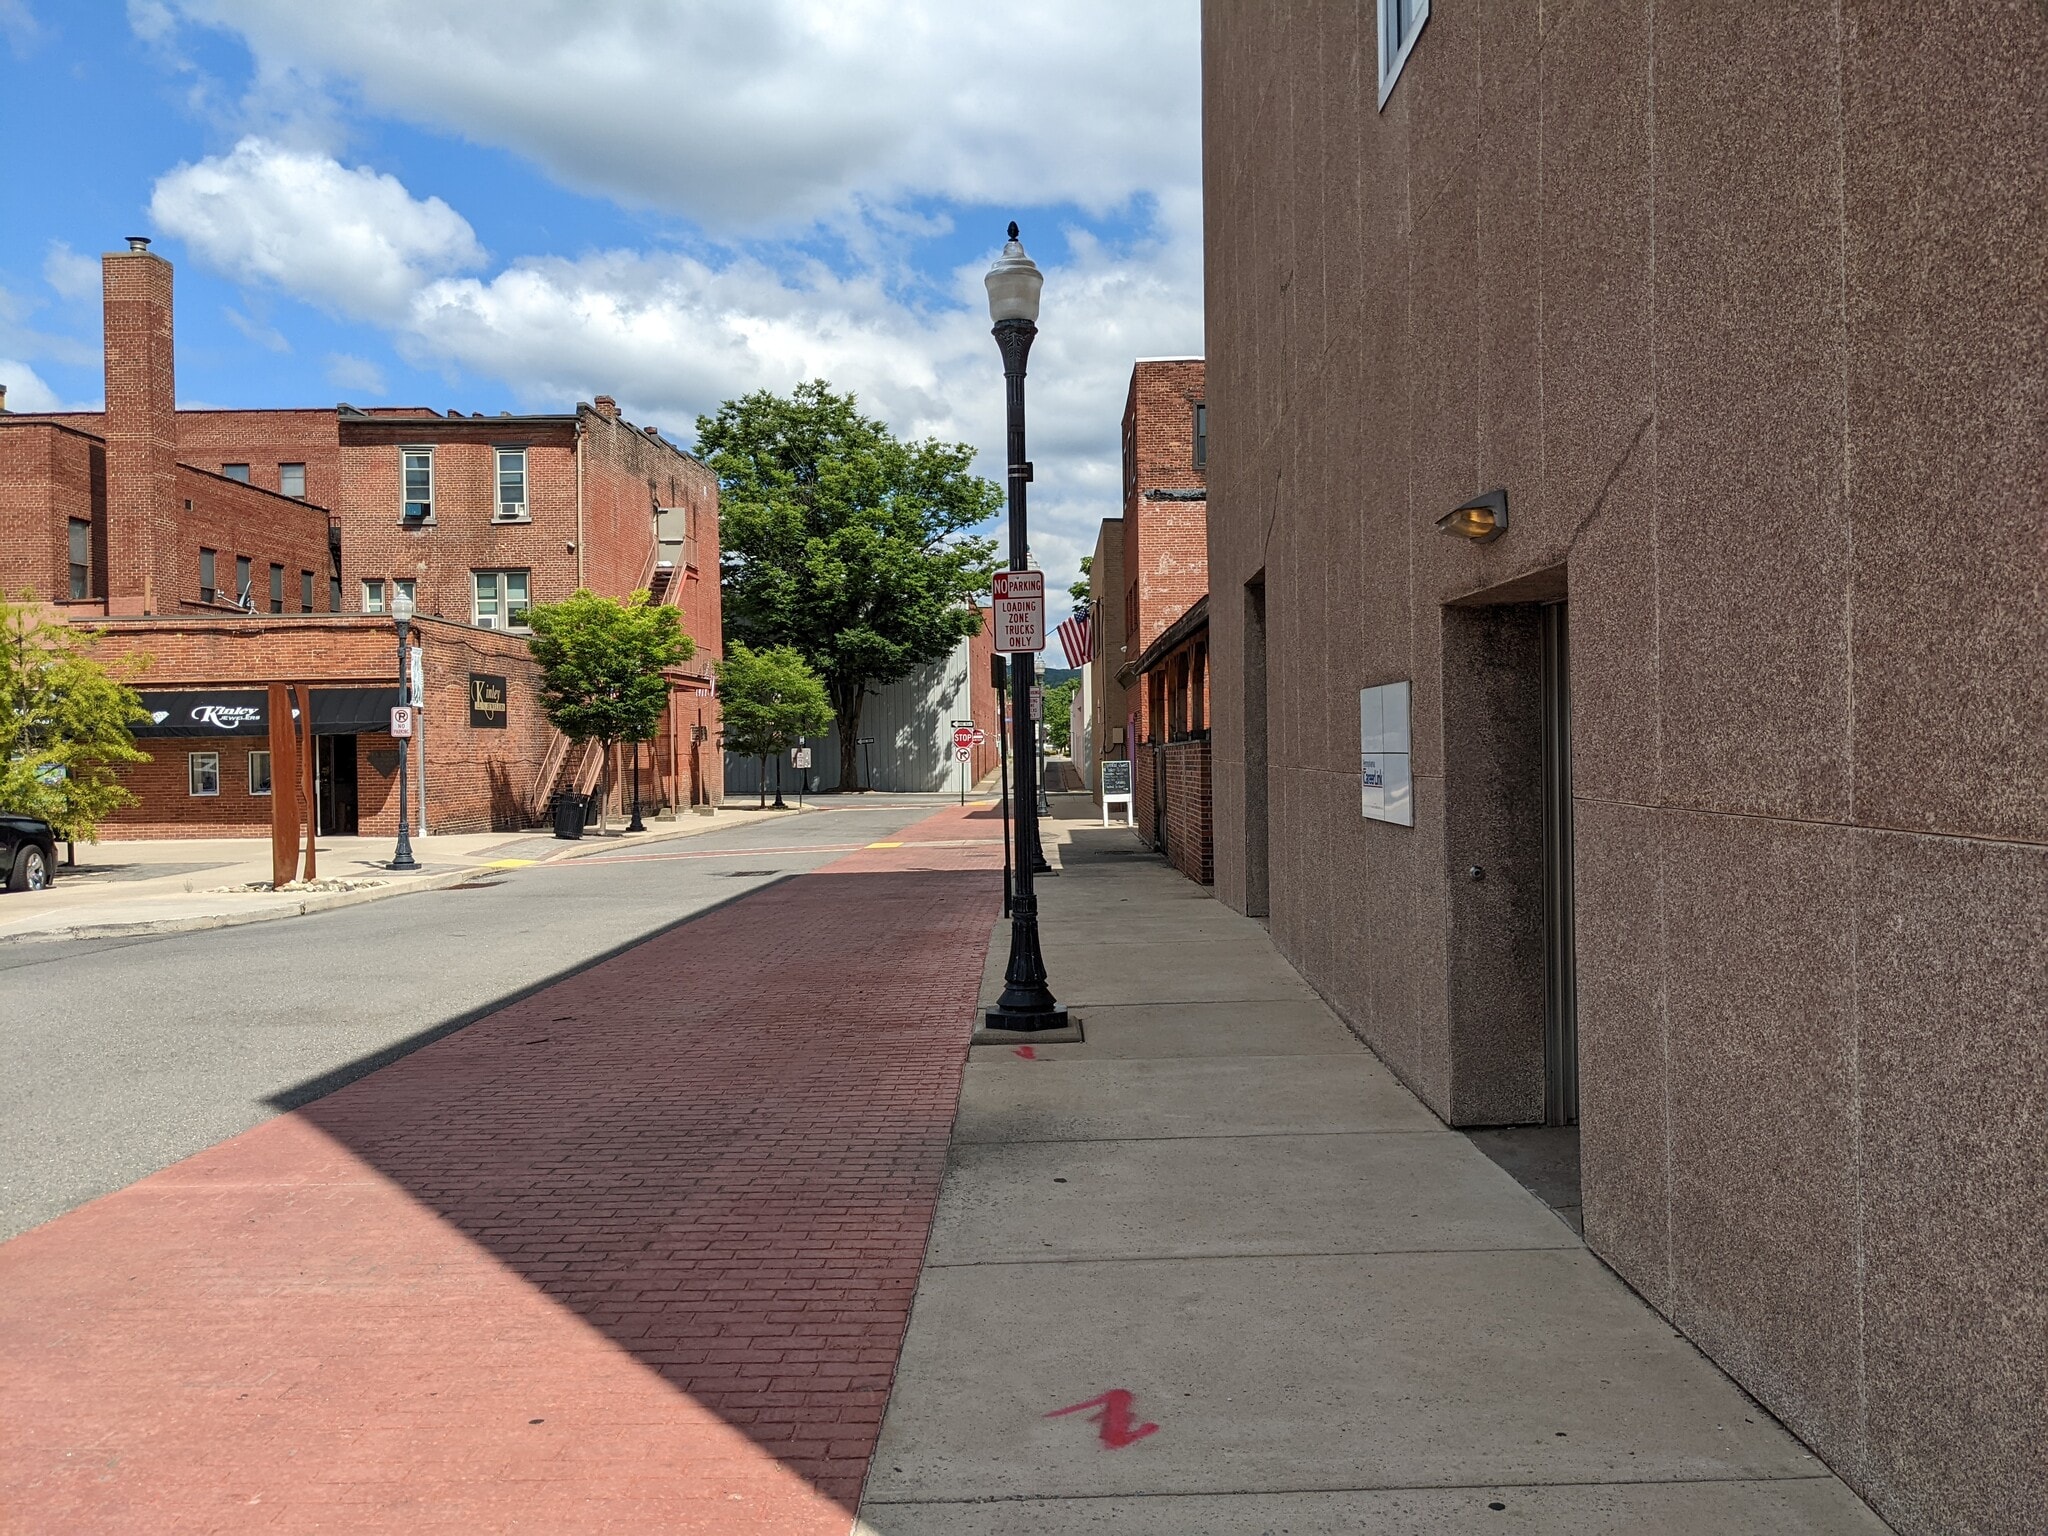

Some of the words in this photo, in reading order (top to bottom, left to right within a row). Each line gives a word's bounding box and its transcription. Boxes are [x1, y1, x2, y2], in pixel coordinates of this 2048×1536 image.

[994, 578, 1008, 595] NO
[1009, 580, 1041, 592] PARKING
[1002, 601, 1036, 612] LOADING
[1008, 613, 1029, 623] ZONE
[1005, 624, 1035, 635] TRUCKS
[1009, 636, 1032, 648] ONLY
[191, 705, 260, 729] Kinley
[954, 733, 972, 742] STOP
